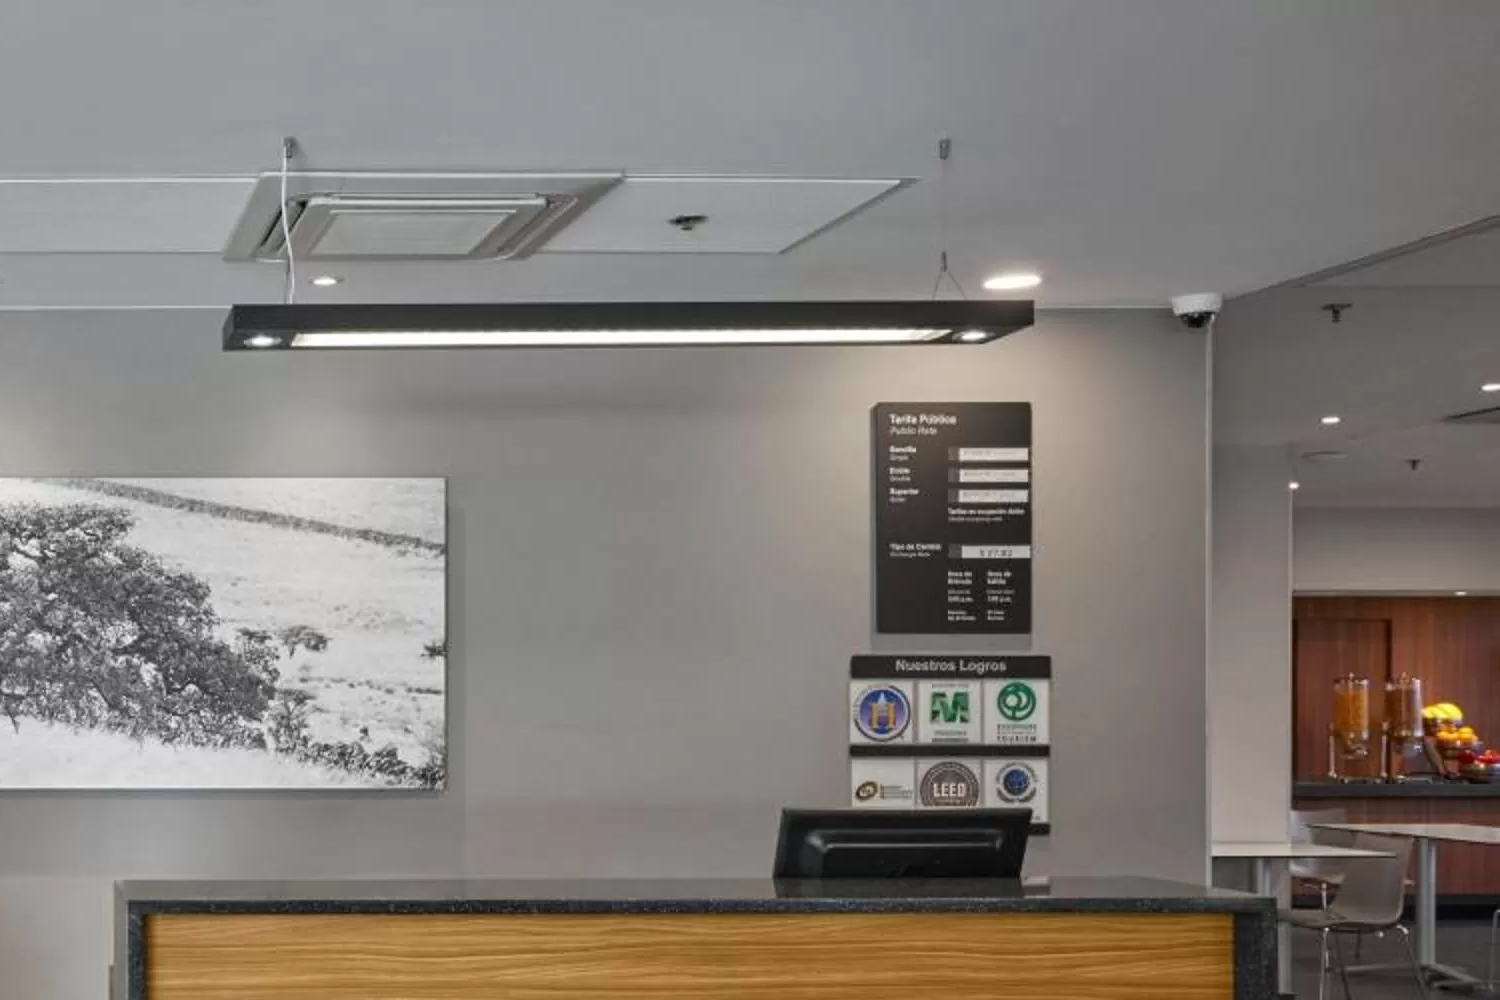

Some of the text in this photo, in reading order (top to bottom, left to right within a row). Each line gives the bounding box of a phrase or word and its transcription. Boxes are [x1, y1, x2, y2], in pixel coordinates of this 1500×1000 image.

[895, 659, 1007, 675] Nuestros Logros
[933, 782, 966, 798] LEED
